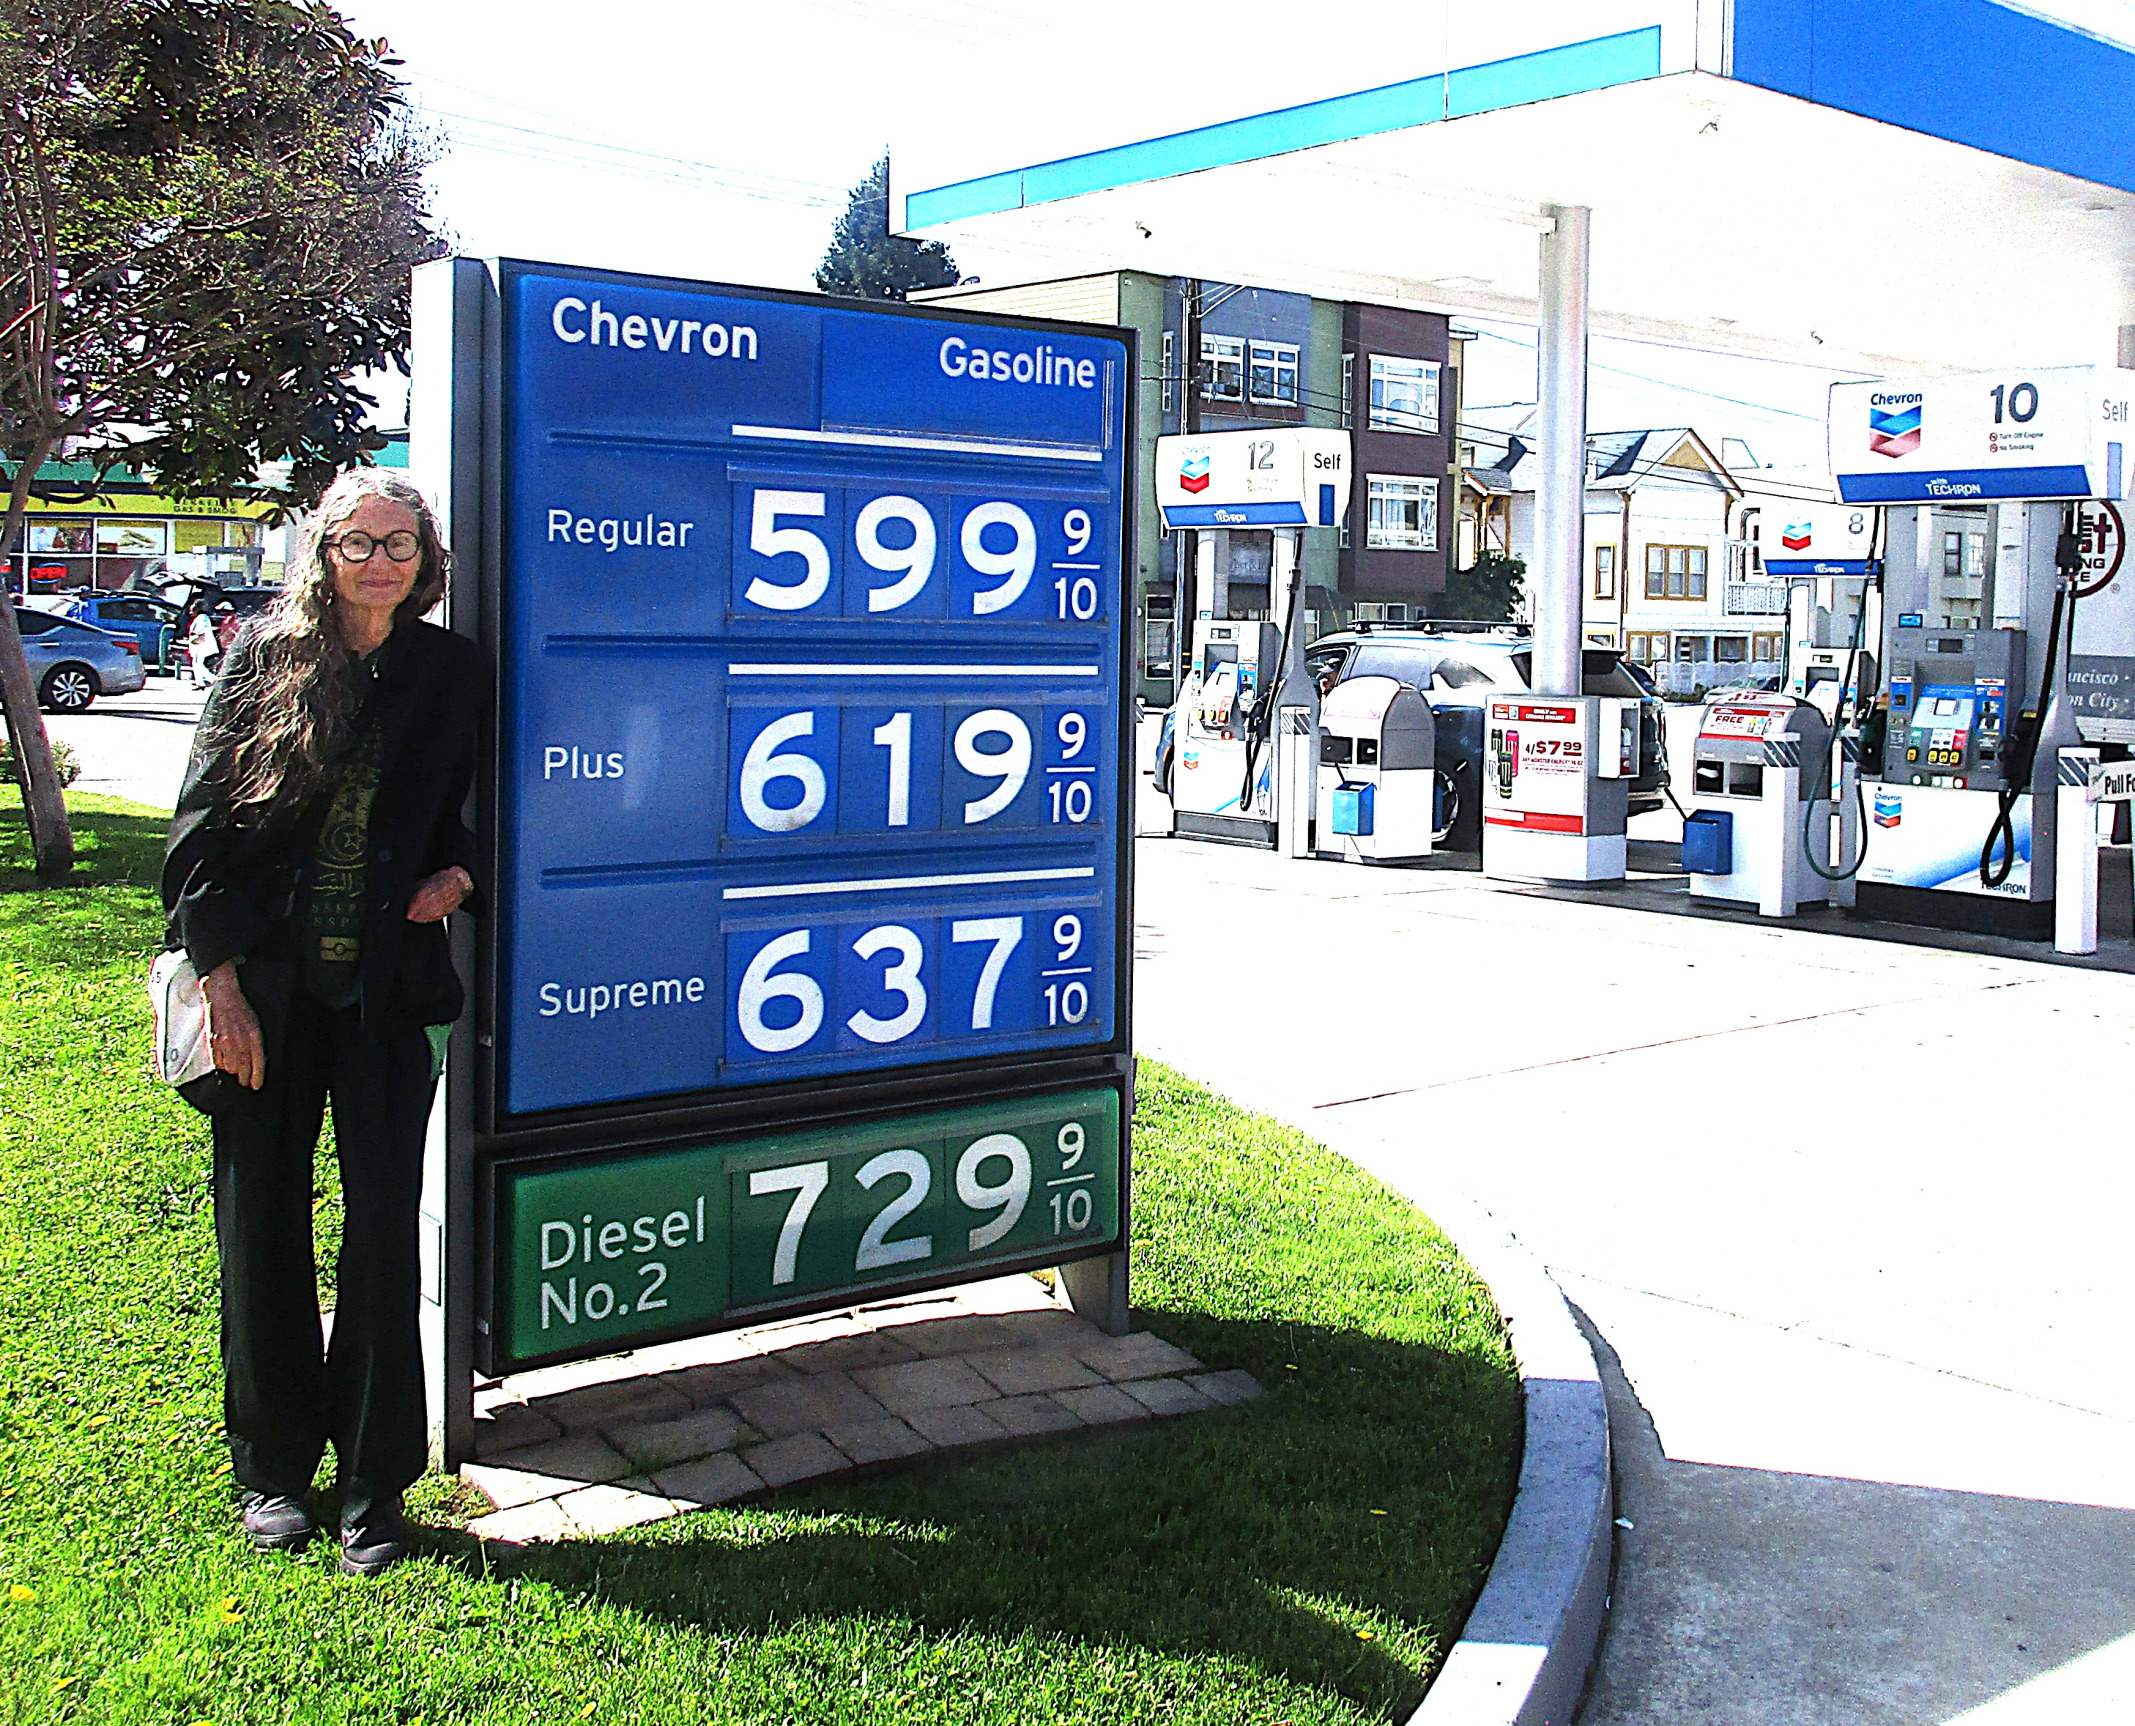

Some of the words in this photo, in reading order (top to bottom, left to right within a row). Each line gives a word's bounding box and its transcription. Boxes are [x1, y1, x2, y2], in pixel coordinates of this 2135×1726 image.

[552, 297, 758, 360] Chevron
[939, 336, 1097, 390] Gasoline
[1870, 393, 1923, 406] Chevron
[1990, 382, 2039, 424] 10
[2102, 399, 2128, 422] Self
[1248, 440, 1275, 470] 12
[1314, 452, 1341, 470] Self
[1925, 483, 1981, 497] TECHRON
[1848, 512, 1864, 535] 8
[547, 510, 695, 553] Regular
[744, 488, 1037, 615] 599
[2088, 692, 2120, 712] City
[1714, 715, 1745, 724] FREE
[543, 746, 624, 780] Plus
[740, 708, 1033, 833] 619
[2104, 774, 2124, 795] Pull
[1874, 792, 1903, 801] Chevron
[539, 976, 705, 1019] Supreme
[737, 916, 1023, 1053] 637
[541, 1195, 705, 1270] Diesel
[749, 1132, 1032, 1285] 729
[541, 1261, 669, 1330] No.2
